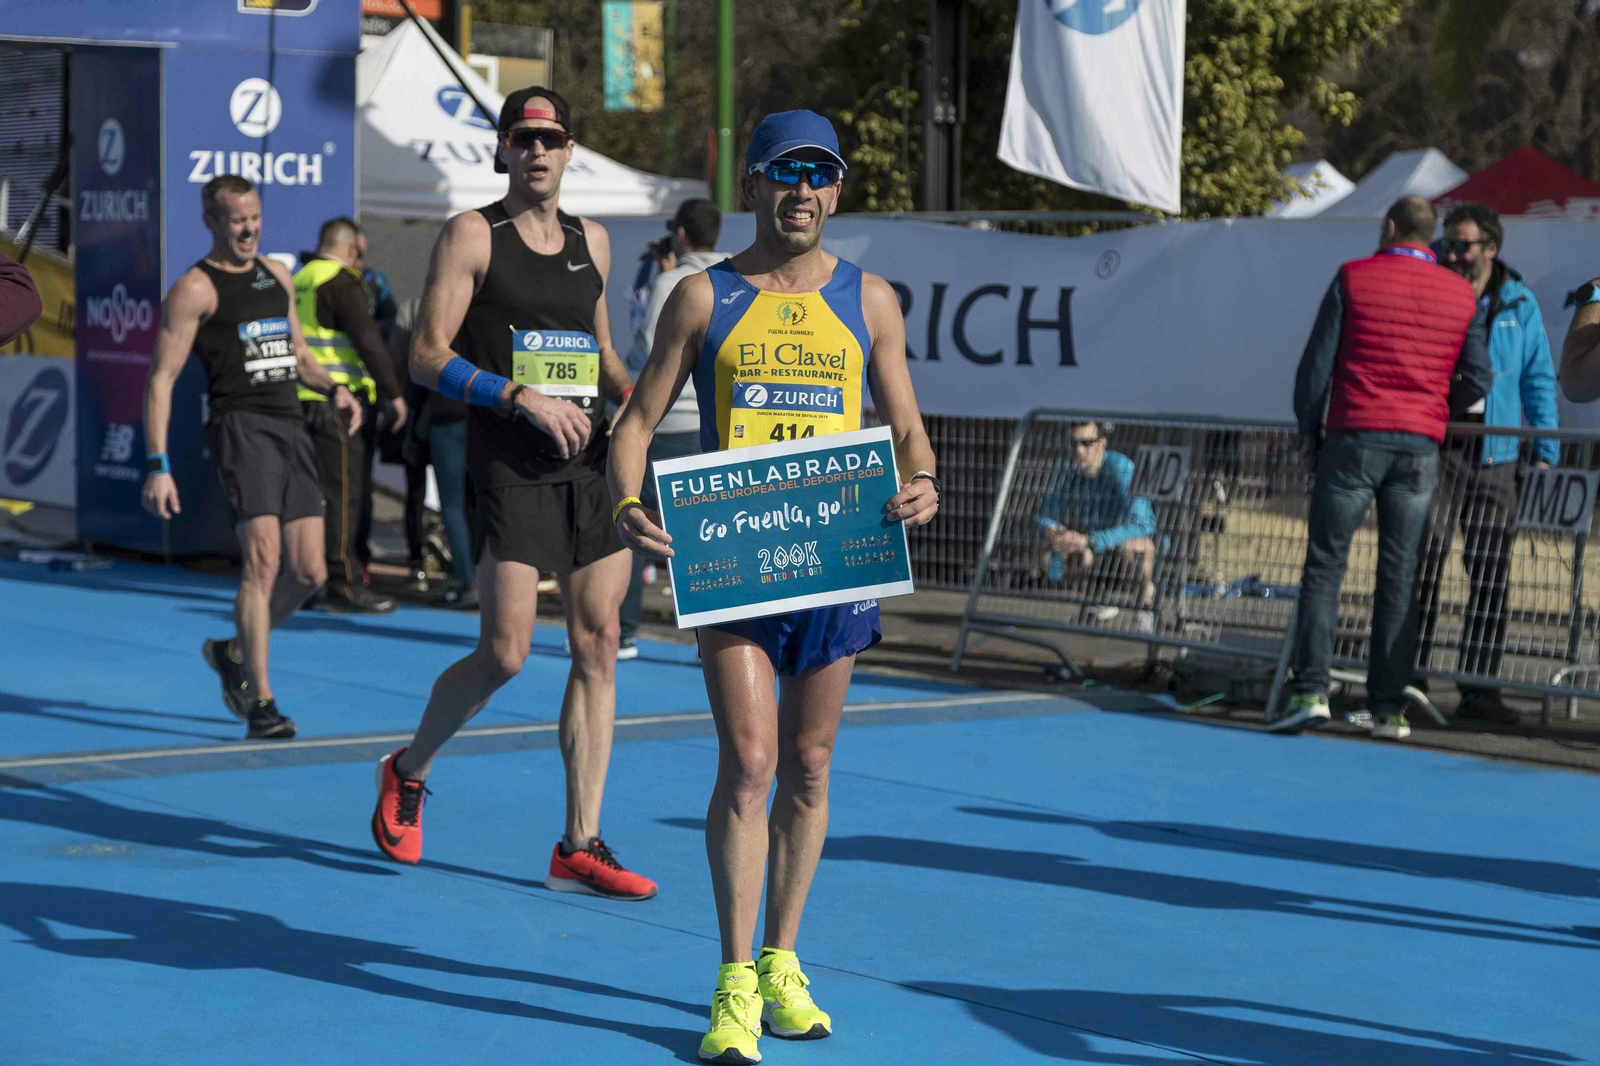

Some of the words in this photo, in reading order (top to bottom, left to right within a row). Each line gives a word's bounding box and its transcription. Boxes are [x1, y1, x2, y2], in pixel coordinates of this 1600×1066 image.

[188, 150, 323, 185] ZURICH
[80, 190, 149, 222] ZURICH
[545, 336, 591, 348] ZURICH
[738, 343, 767, 366] El
[774, 343, 846, 370] Clavel
[544, 362, 577, 380] 785
[740, 369, 761, 378] BAR
[772, 391, 838, 408] ZURICH
[769, 422, 815, 442] 414
[670, 450, 884, 498] FUENLABRADA
[673, 492, 717, 508] CIUDAD
[720, 484, 776, 501] EUROPEA
[779, 480, 801, 491] DEL
[803, 470, 856, 487] DEPORTE
[858, 467, 885, 478] 2019
[1519, 471, 1588, 526] IMD
[699, 518, 728, 542] Go
[733, 503, 811, 534] Fuenla,
[761, 572, 788, 584] UNITED
[788, 569, 798, 579] BY
[799, 566, 823, 578] SPORT
